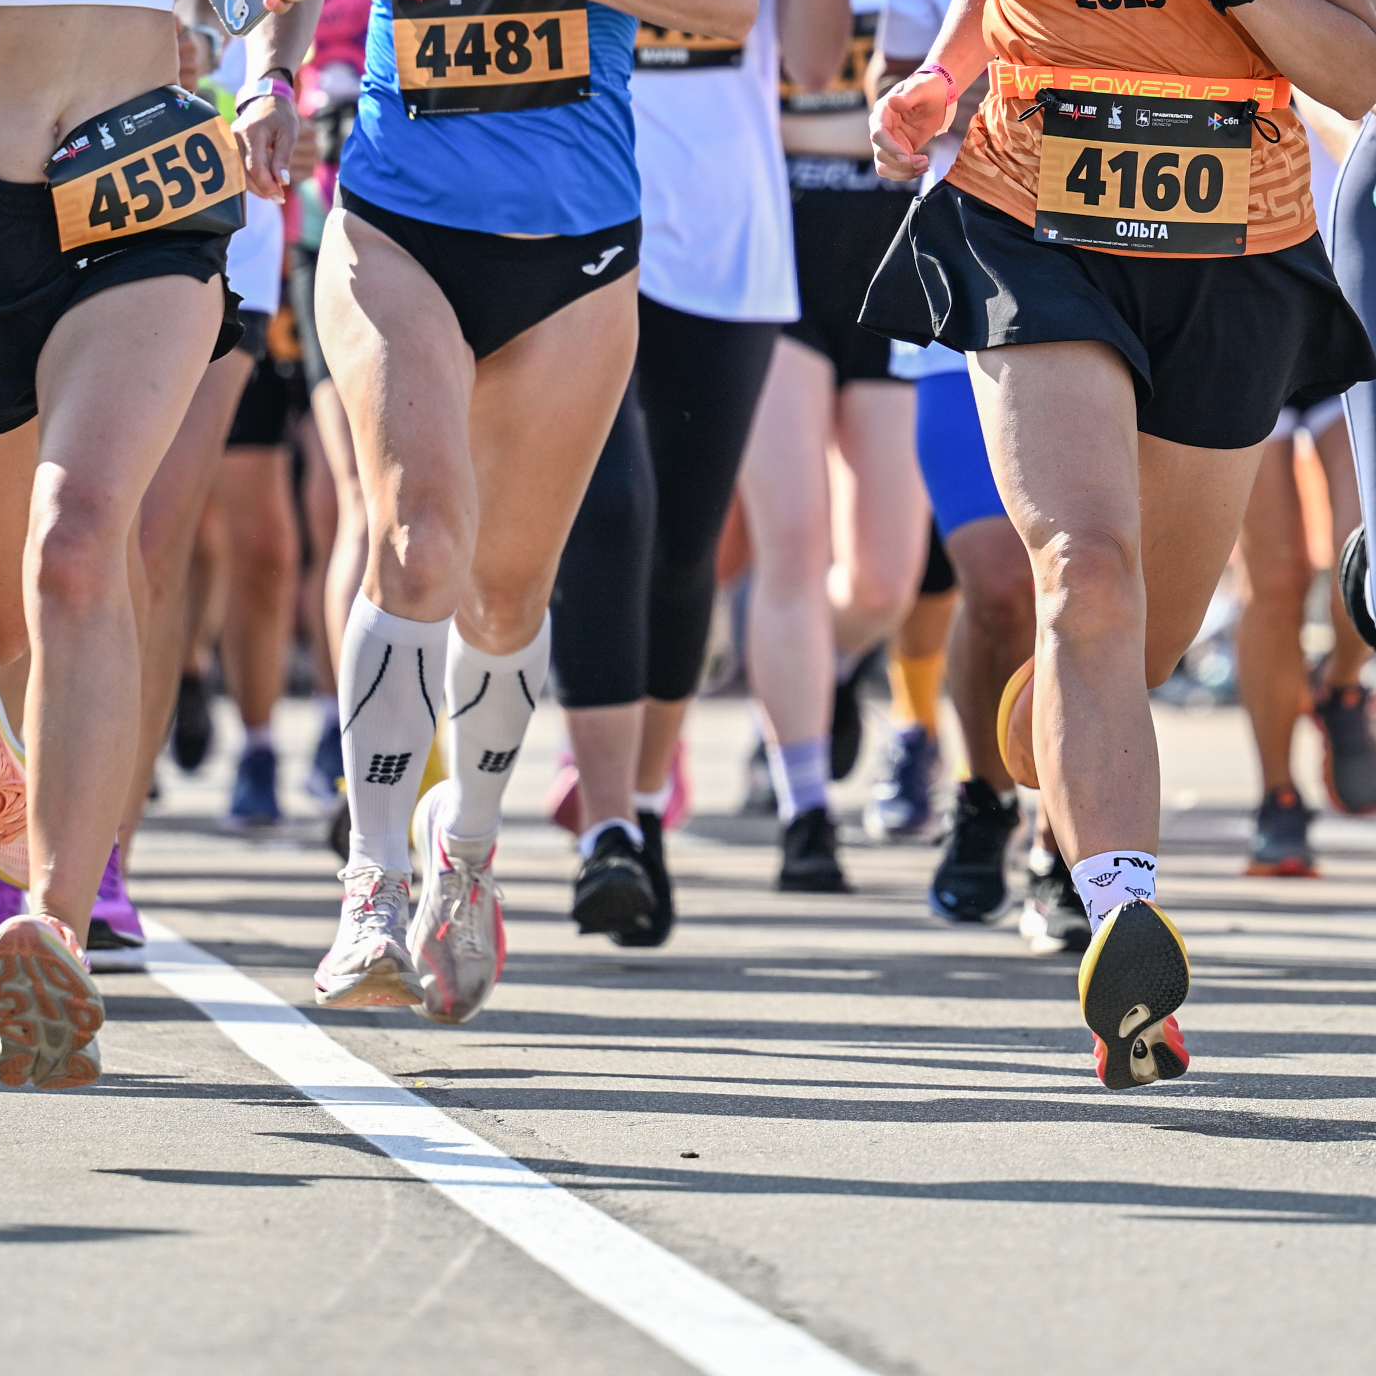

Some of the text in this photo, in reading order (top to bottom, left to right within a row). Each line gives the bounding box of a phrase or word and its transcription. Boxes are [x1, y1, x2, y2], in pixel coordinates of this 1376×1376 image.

[415, 18, 564, 79] 4481
[1080, 105, 1098, 116] LADY
[1223, 117, 1240, 126] сбп
[88, 132, 226, 232] 4559
[1065, 146, 1225, 214] 4160
[1115, 220, 1169, 240] ОЛЬГА
[364, 773, 404, 786] cep
